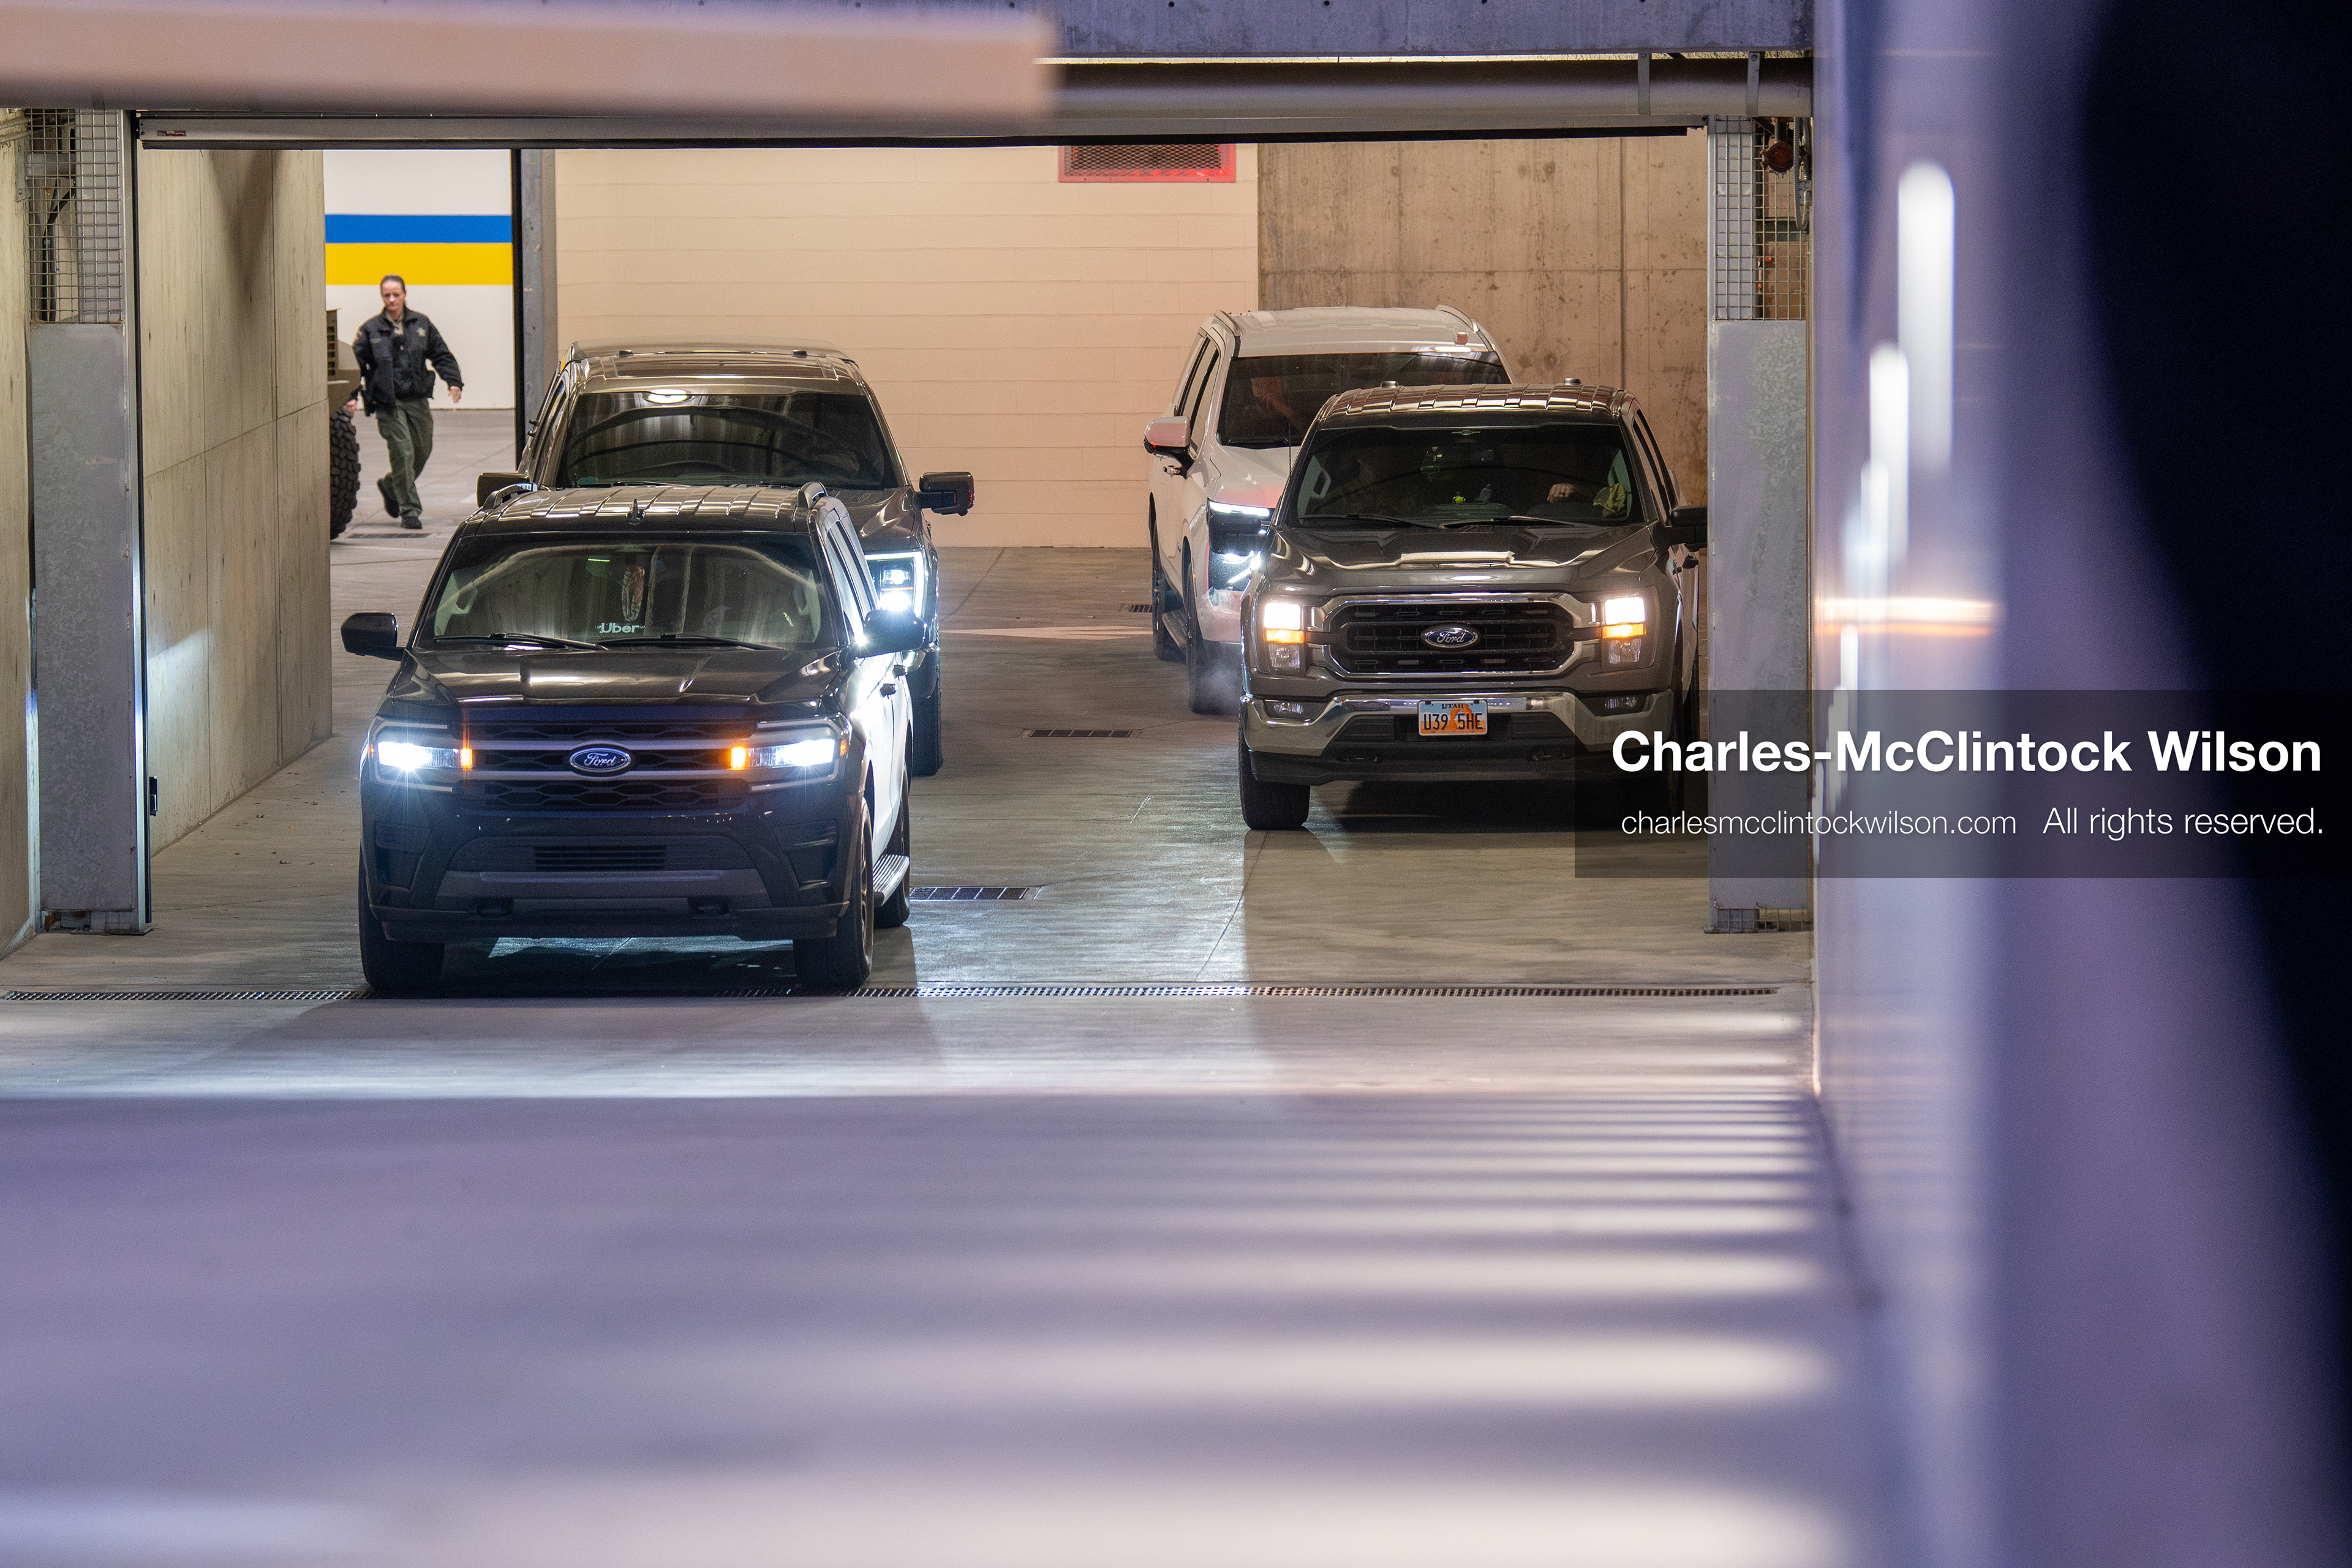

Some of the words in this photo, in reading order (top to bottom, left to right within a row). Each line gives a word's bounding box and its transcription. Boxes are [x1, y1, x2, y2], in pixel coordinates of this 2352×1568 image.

[601, 622, 639, 633] Uber
[1437, 630, 1466, 643] Ford
[1423, 713, 1449, 731] U39
[1457, 712, 1483, 730] 5HE
[584, 752, 616, 766] Ford
